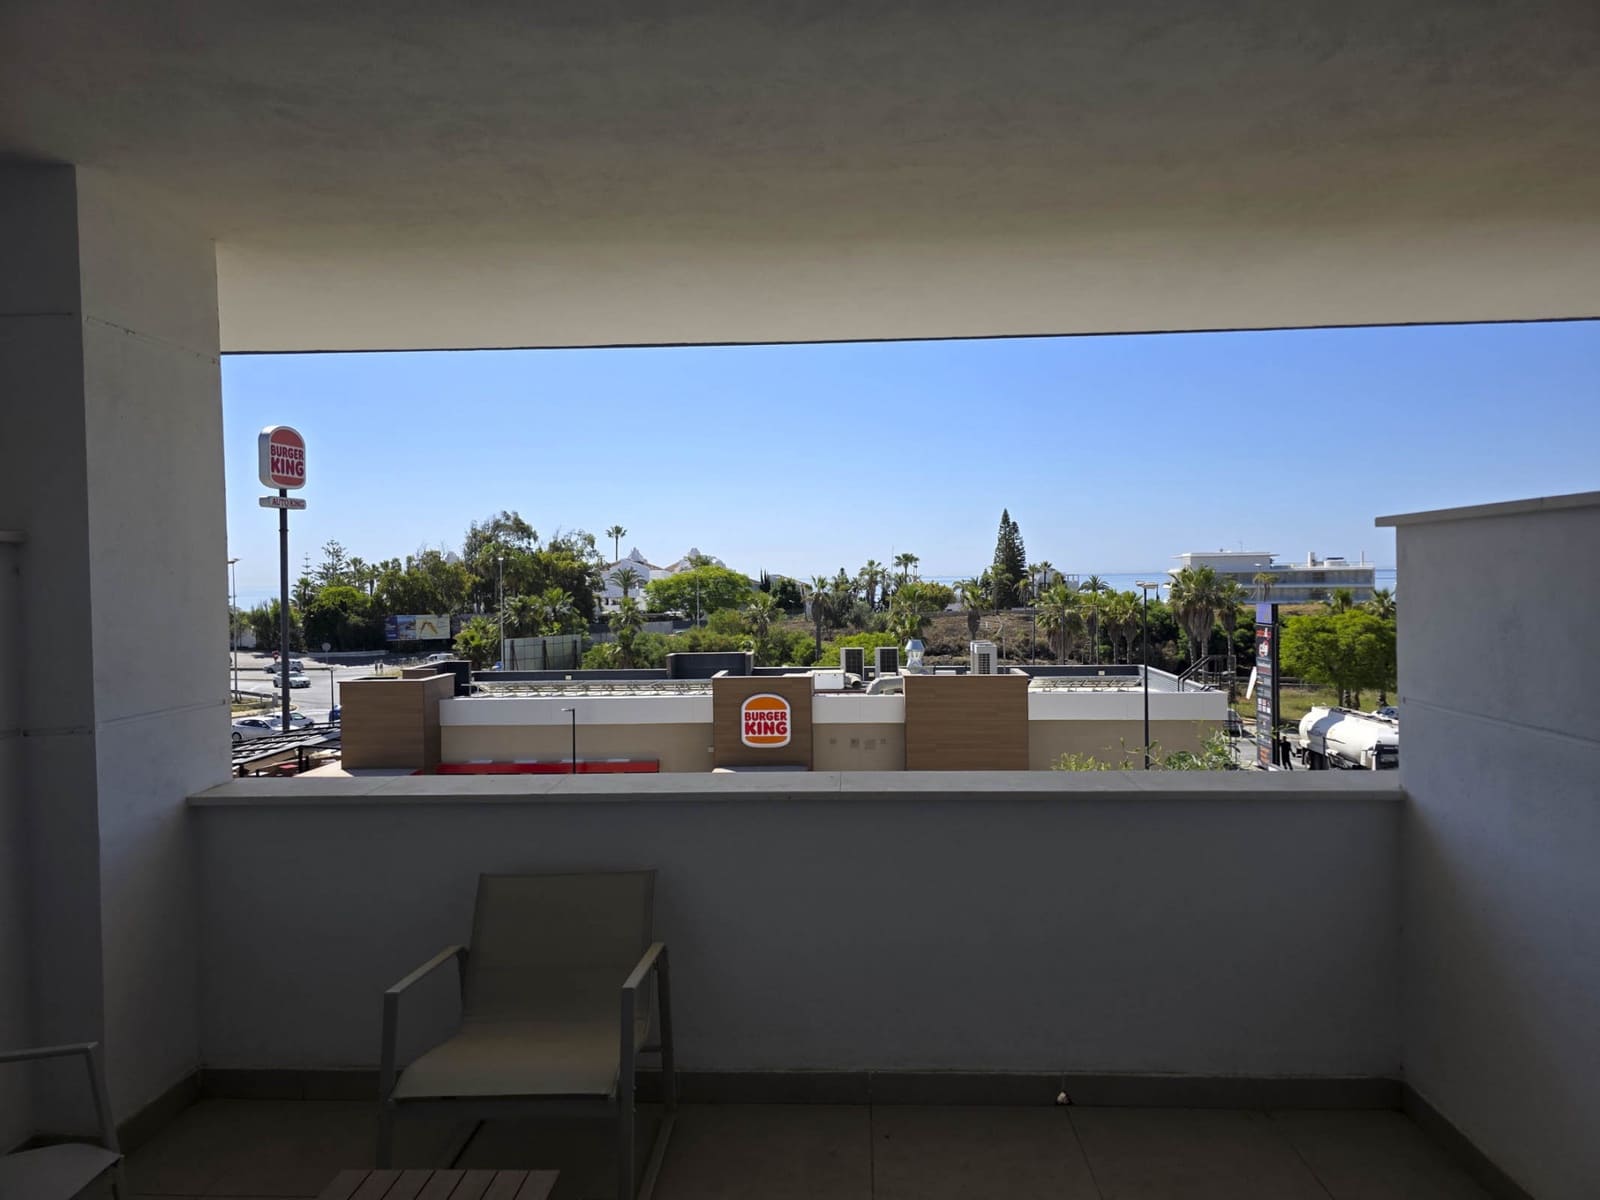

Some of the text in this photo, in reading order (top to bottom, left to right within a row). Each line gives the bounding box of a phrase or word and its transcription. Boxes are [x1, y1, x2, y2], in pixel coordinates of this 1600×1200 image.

[271, 445, 304, 460] BURGER
[271, 457, 304, 476] KING
[272, 498, 305, 508] AUTO KING
[744, 711, 787, 721] BURGER
[744, 721, 787, 735] KING
